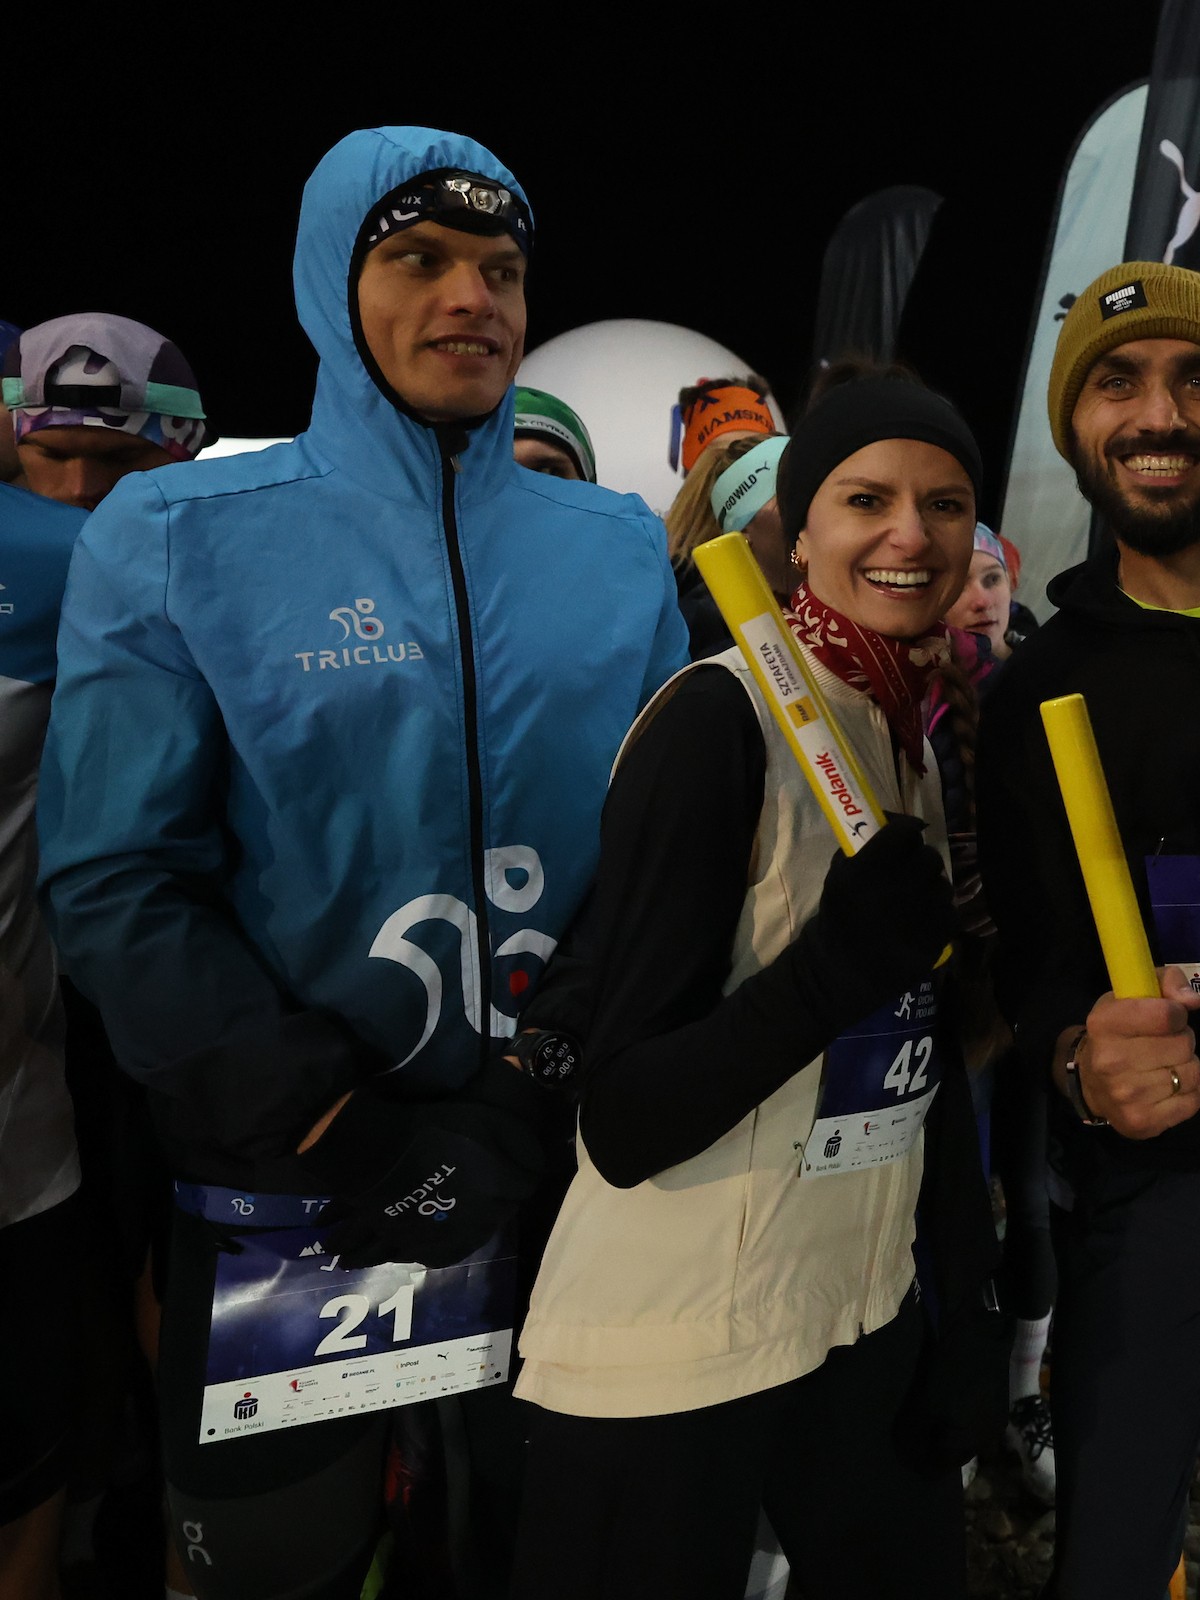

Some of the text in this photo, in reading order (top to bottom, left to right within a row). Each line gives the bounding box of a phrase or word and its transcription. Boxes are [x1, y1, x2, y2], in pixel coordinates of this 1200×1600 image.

[1105, 285, 1136, 305] PUMA
[726, 474, 758, 511] GOWILD
[295, 641, 424, 672] TRICLUB
[759, 641, 793, 697] SZTAFETA
[815, 751, 863, 817] polanik
[882, 1036, 933, 1096] 42
[384, 1164, 457, 1217] TRICLUB
[314, 1283, 416, 1356] 21
[224, 1420, 265, 1435] Bank Polski
